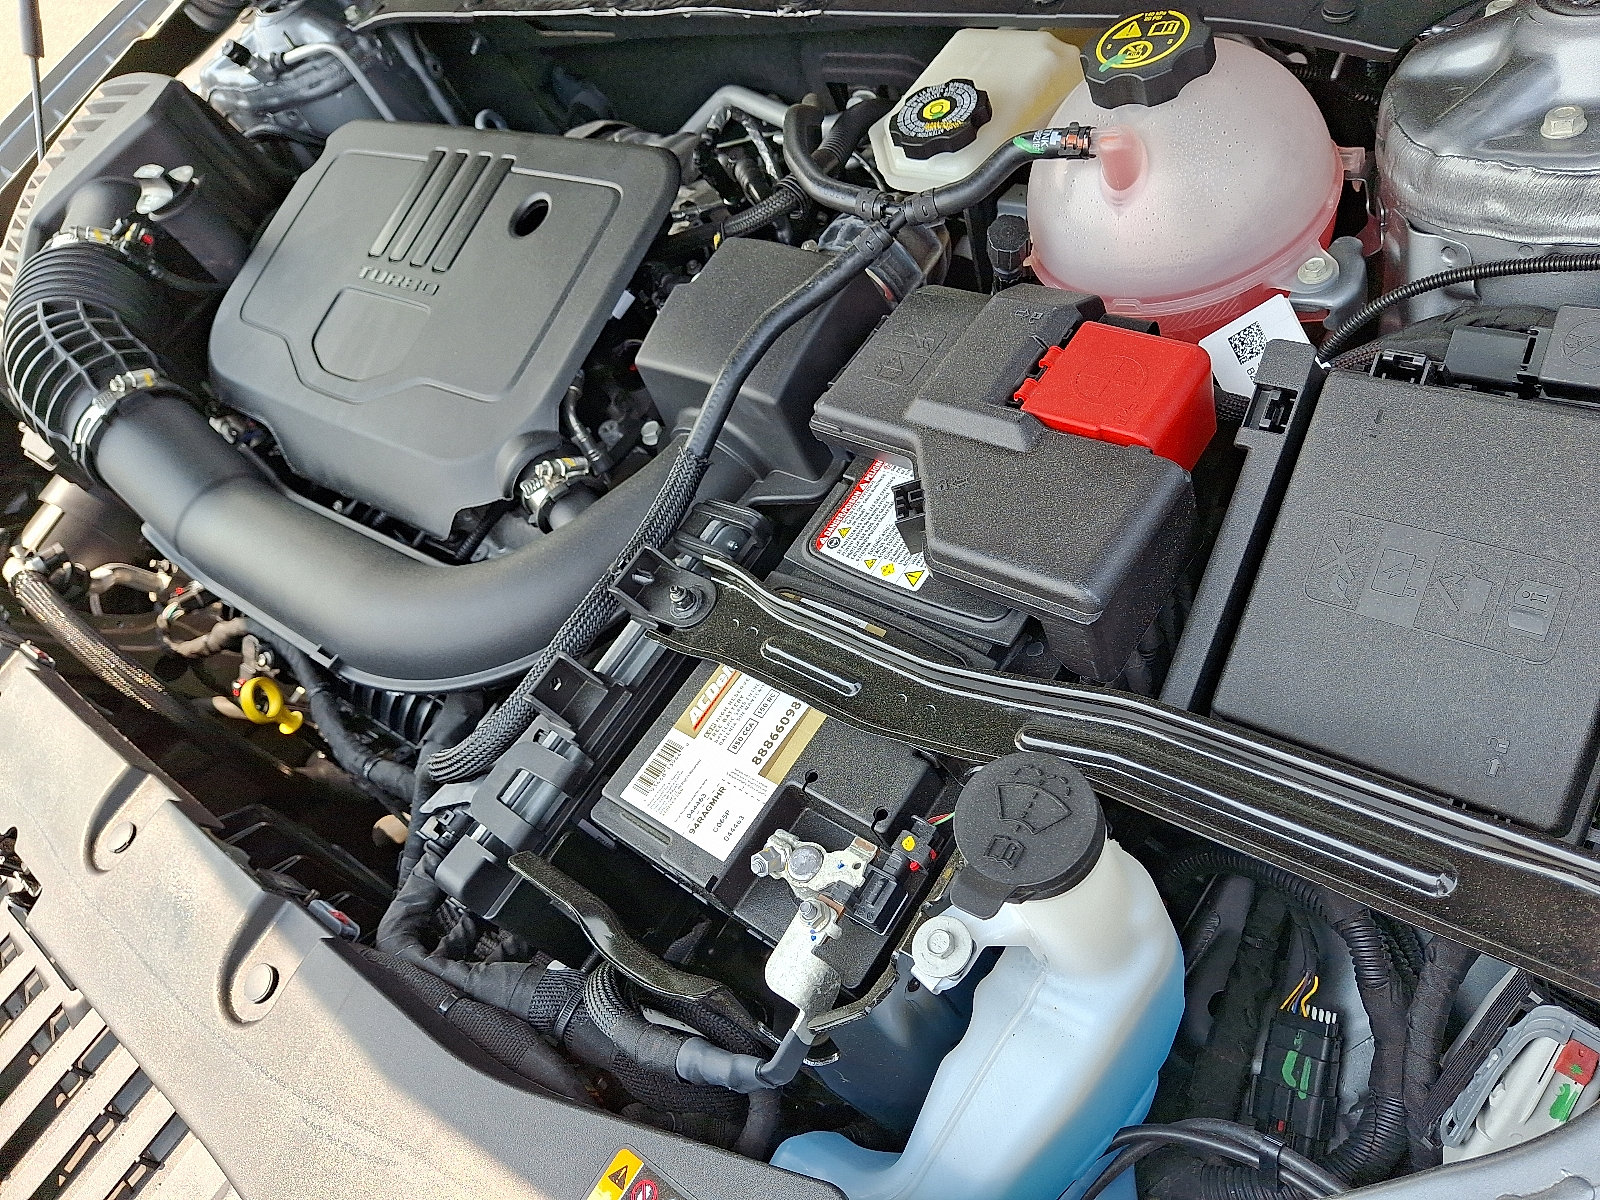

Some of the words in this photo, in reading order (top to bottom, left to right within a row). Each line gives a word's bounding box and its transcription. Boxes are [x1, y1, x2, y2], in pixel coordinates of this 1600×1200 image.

[358, 264, 440, 296] TURBO
[825, 490, 860, 536] DANGER/POISON
[689, 665, 736, 726] ACDel
[731, 736, 744, 750] 850
[742, 721, 754, 736] CCA
[751, 699, 802, 765] 88866098
[688, 785, 726, 835] 94RAGMHR
